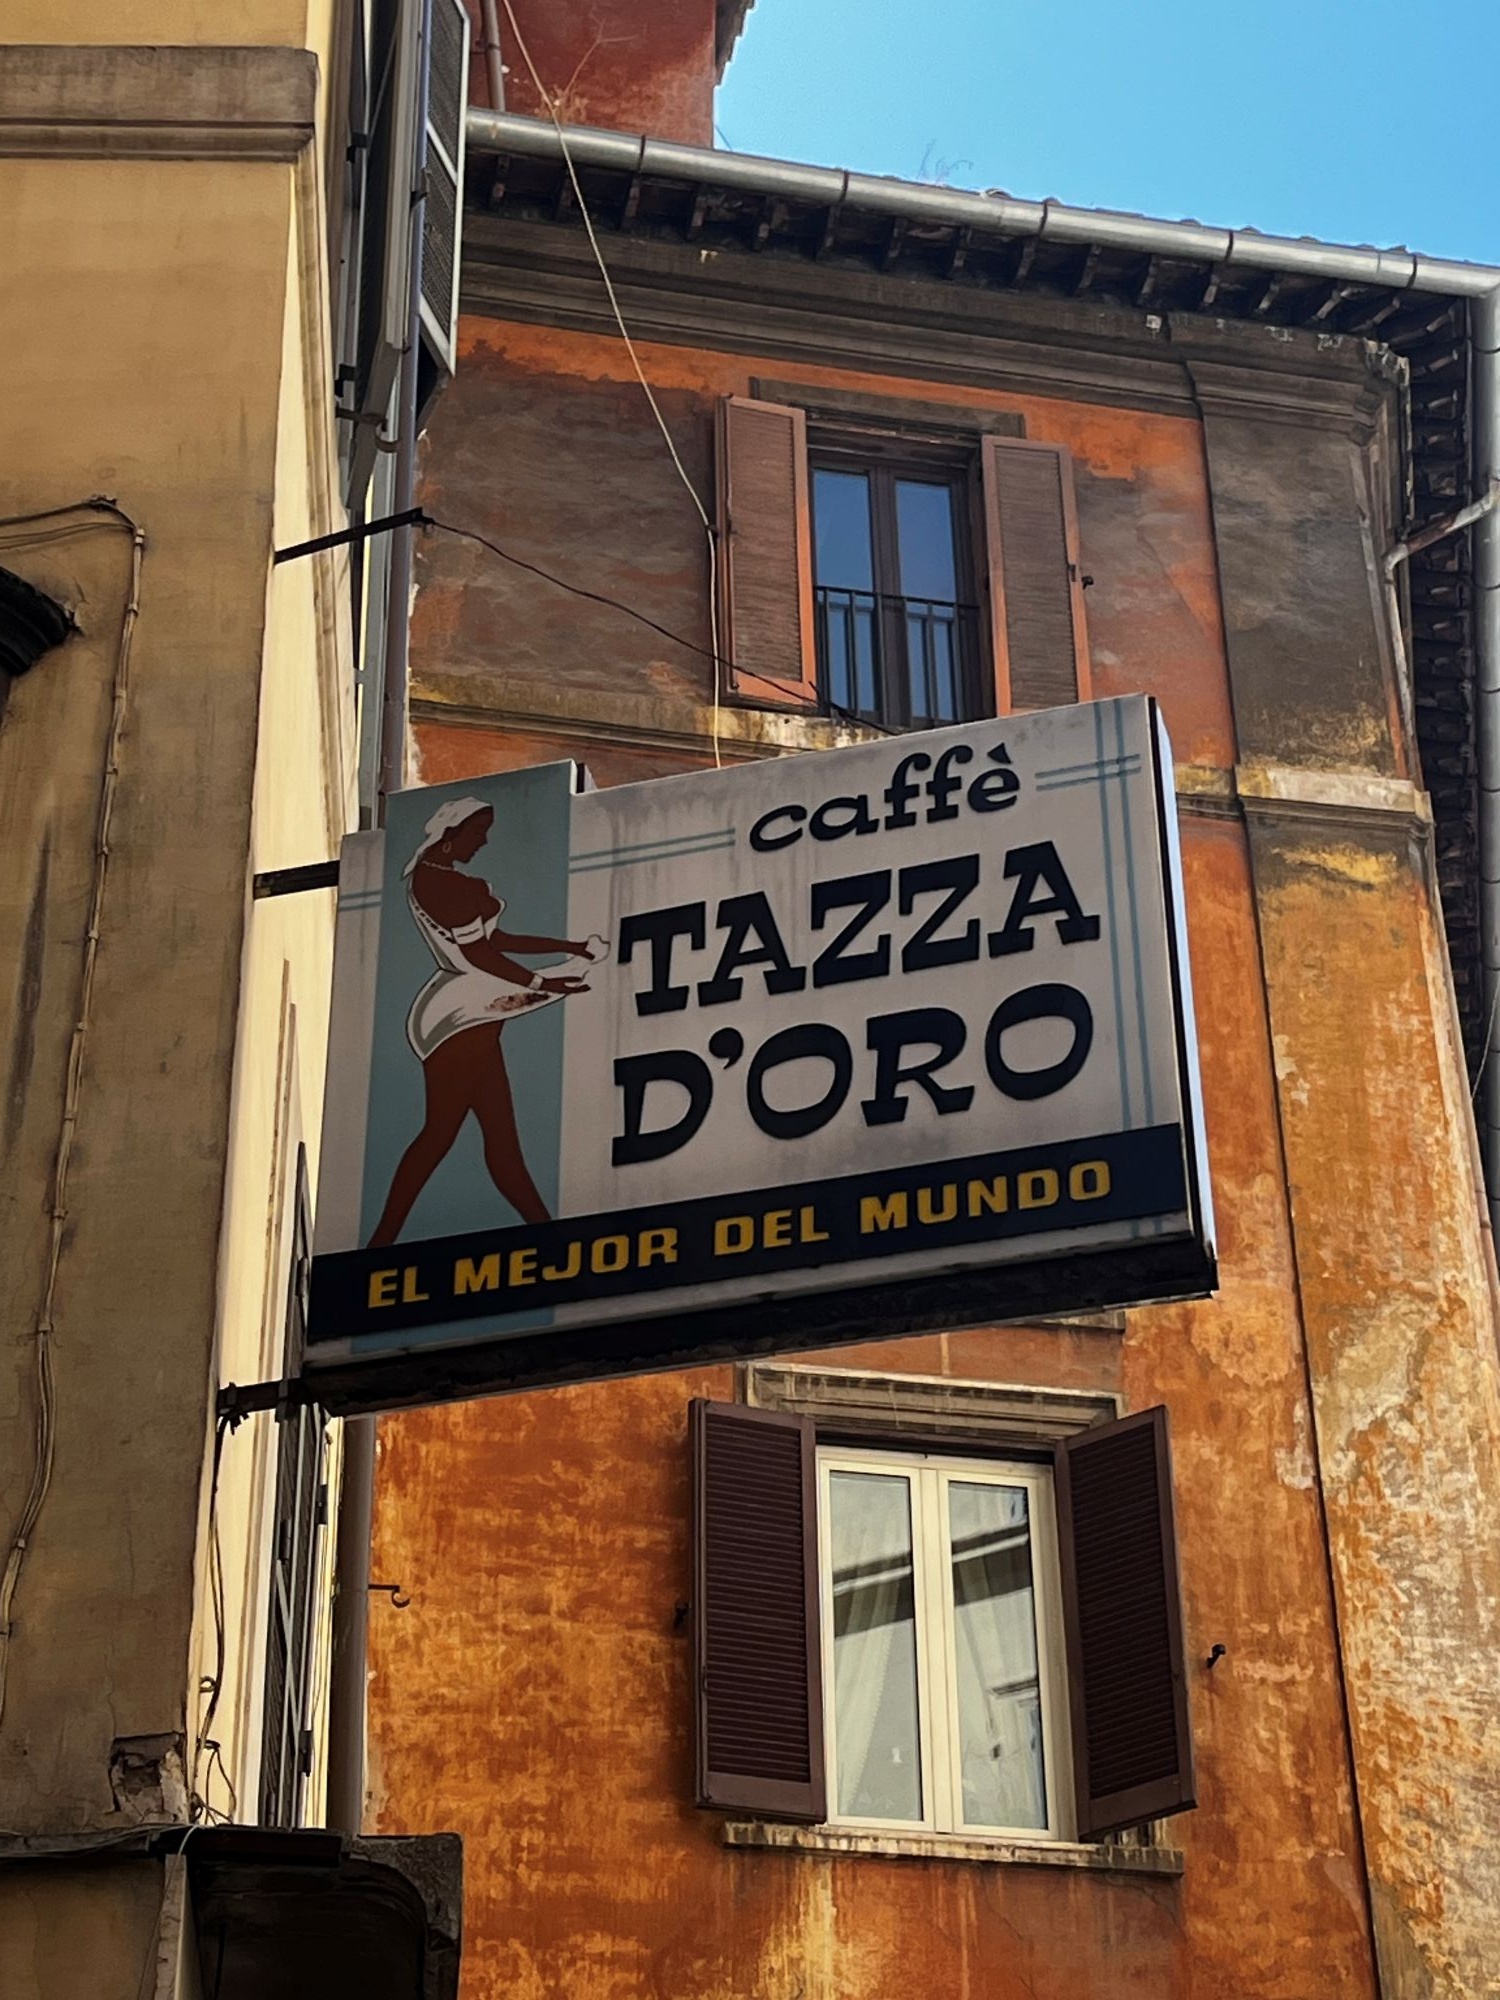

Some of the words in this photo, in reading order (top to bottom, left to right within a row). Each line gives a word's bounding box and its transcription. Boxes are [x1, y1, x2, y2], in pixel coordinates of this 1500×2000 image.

[749, 743, 1020, 853] caffè
[617, 841, 1100, 1017] TAZZA
[611, 983, 1093, 1168] D'ORO
[367, 1268, 429, 1309] EL
[453, 1228, 679, 1296] MEJOR
[714, 1206, 829, 1256] DEL
[860, 1162, 1111, 1235] MUNDO
